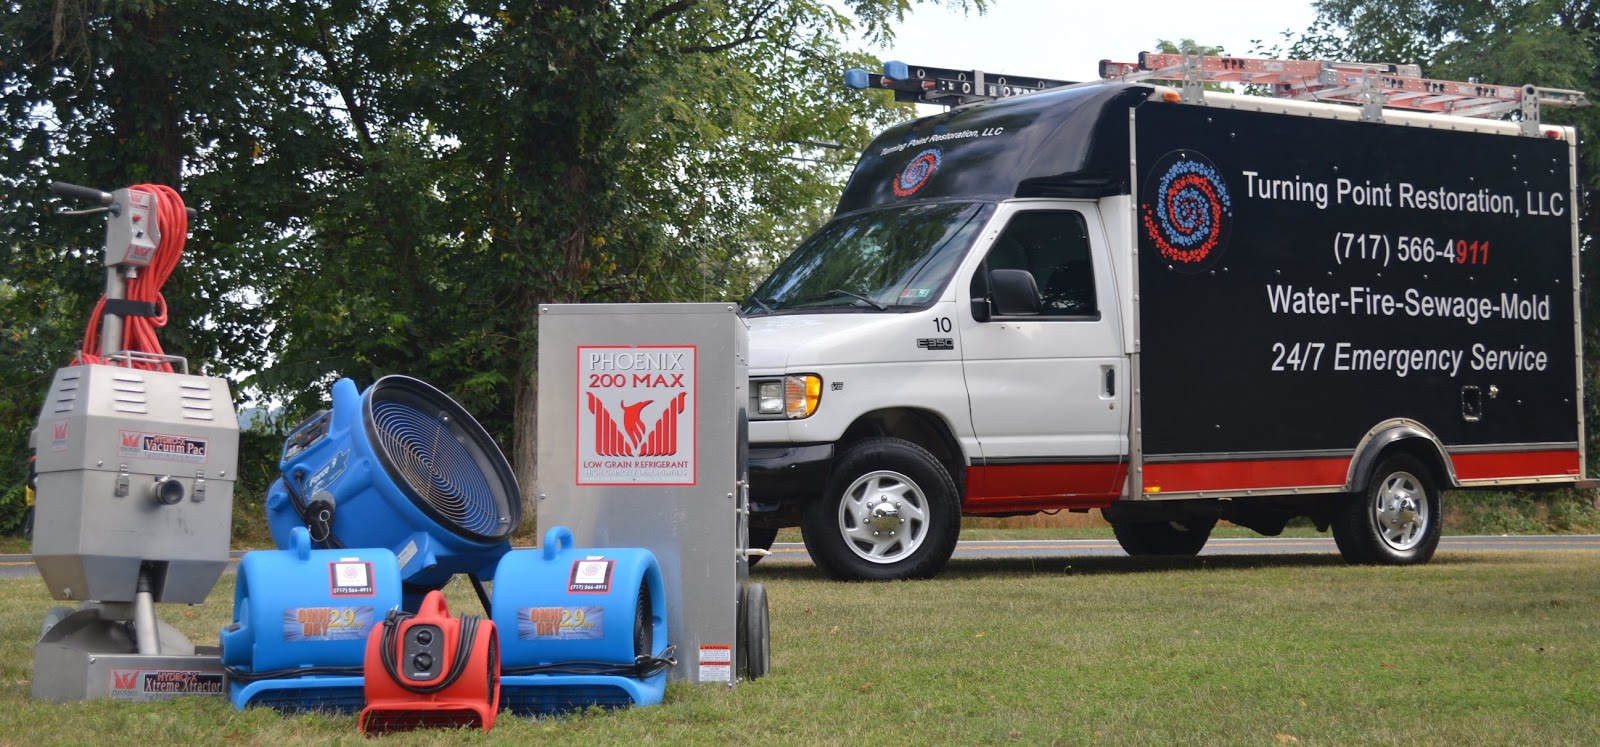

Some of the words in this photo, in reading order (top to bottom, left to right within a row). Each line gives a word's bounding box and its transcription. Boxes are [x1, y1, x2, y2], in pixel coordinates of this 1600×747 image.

[1221, 58, 1245, 70] TPR
[1424, 81, 1445, 93] TPR
[1475, 86, 1496, 98] TPR
[907, 137, 928, 148] Point
[929, 130, 979, 143] Restoration,
[981, 127, 1004, 137] LLC
[1242, 170, 1329, 210] Turning
[1336, 178, 1392, 207] Point
[1399, 182, 1520, 218] Restoration,
[1526, 191, 1564, 217] LLC
[1333, 231, 1390, 267] (717)
[1397, 236, 1490, 265] 566-4911
[1266, 284, 1550, 325] Water-Fire-Sewage-Mold
[932, 316, 952, 333] 10
[589, 352, 685, 371] PHOENIX
[1271, 342, 1326, 371] 24/7
[1333, 342, 1463, 377] Emergency
[1469, 342, 1548, 371] Service
[588, 373, 627, 388] 200
[632, 373, 685, 388] MAX
[145, 438, 186, 453] Vacuum
[186, 442, 204, 455] Pac
[583, 460, 603, 469] LOW
[604, 460, 632, 469] GRAIN
[634, 460, 689, 469] REFRIGERANT
[297, 608, 332, 623] OMNI
[530, 608, 563, 622] OMNI
[303, 622, 329, 637] DRY
[536, 622, 561, 636] DRY
[157, 671, 199, 681] HYDRO-X
[145, 677, 180, 692] Xtreme
[180, 679, 221, 692] Xtractor
